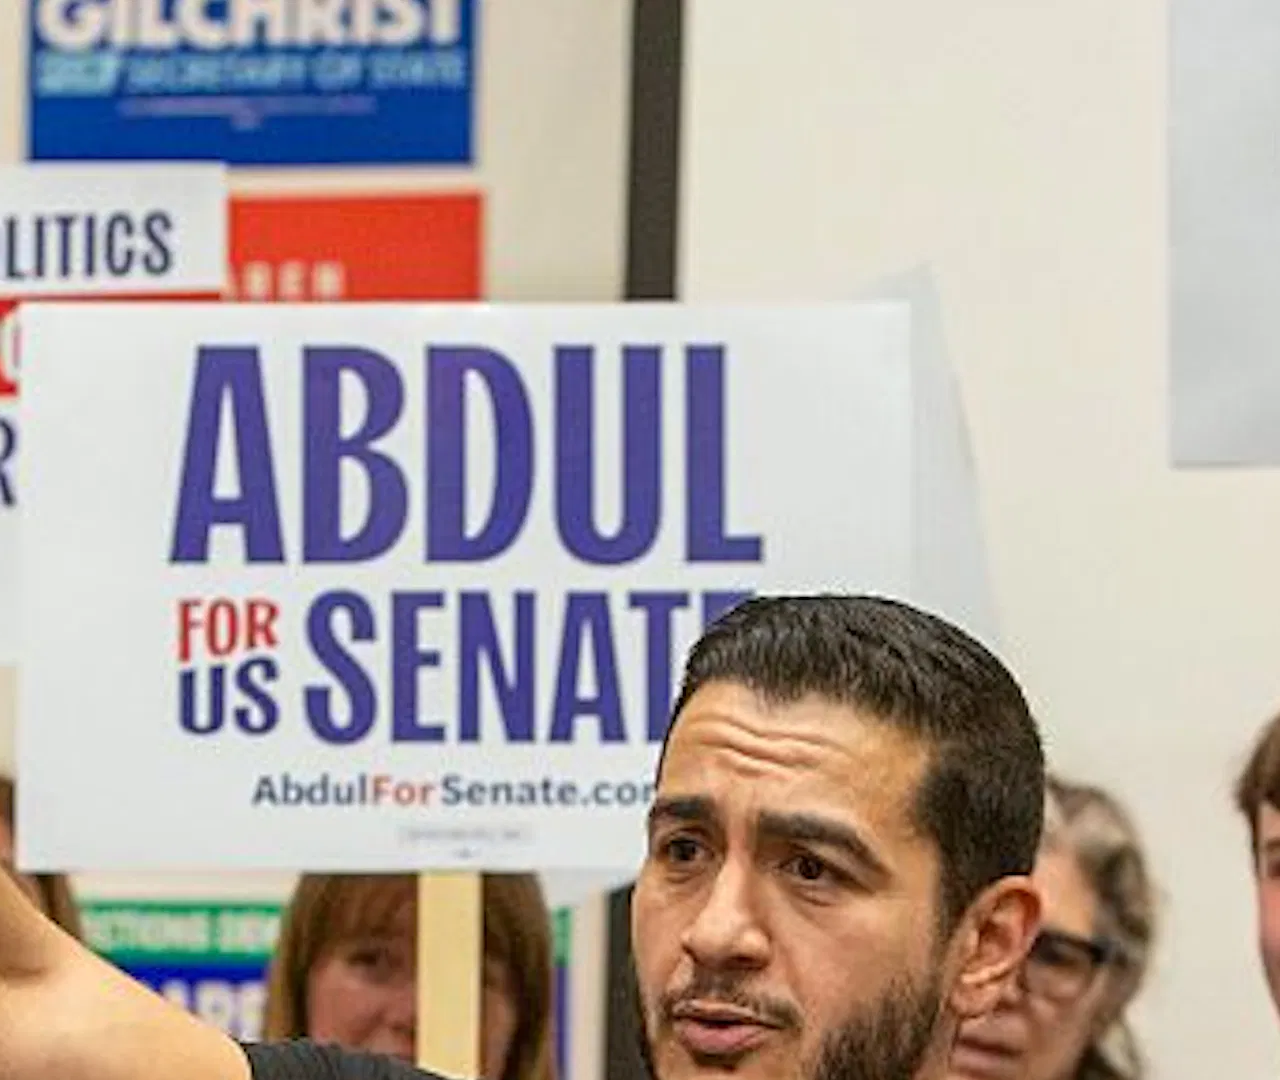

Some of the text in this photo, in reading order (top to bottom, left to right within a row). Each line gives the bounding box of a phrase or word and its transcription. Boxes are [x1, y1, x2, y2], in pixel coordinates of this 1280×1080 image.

[35, 0, 462, 50] GILCHRIST
[169, 344, 764, 566] ABDUL
[176, 597, 280, 663] FOR
[177, 656, 280, 735] US
